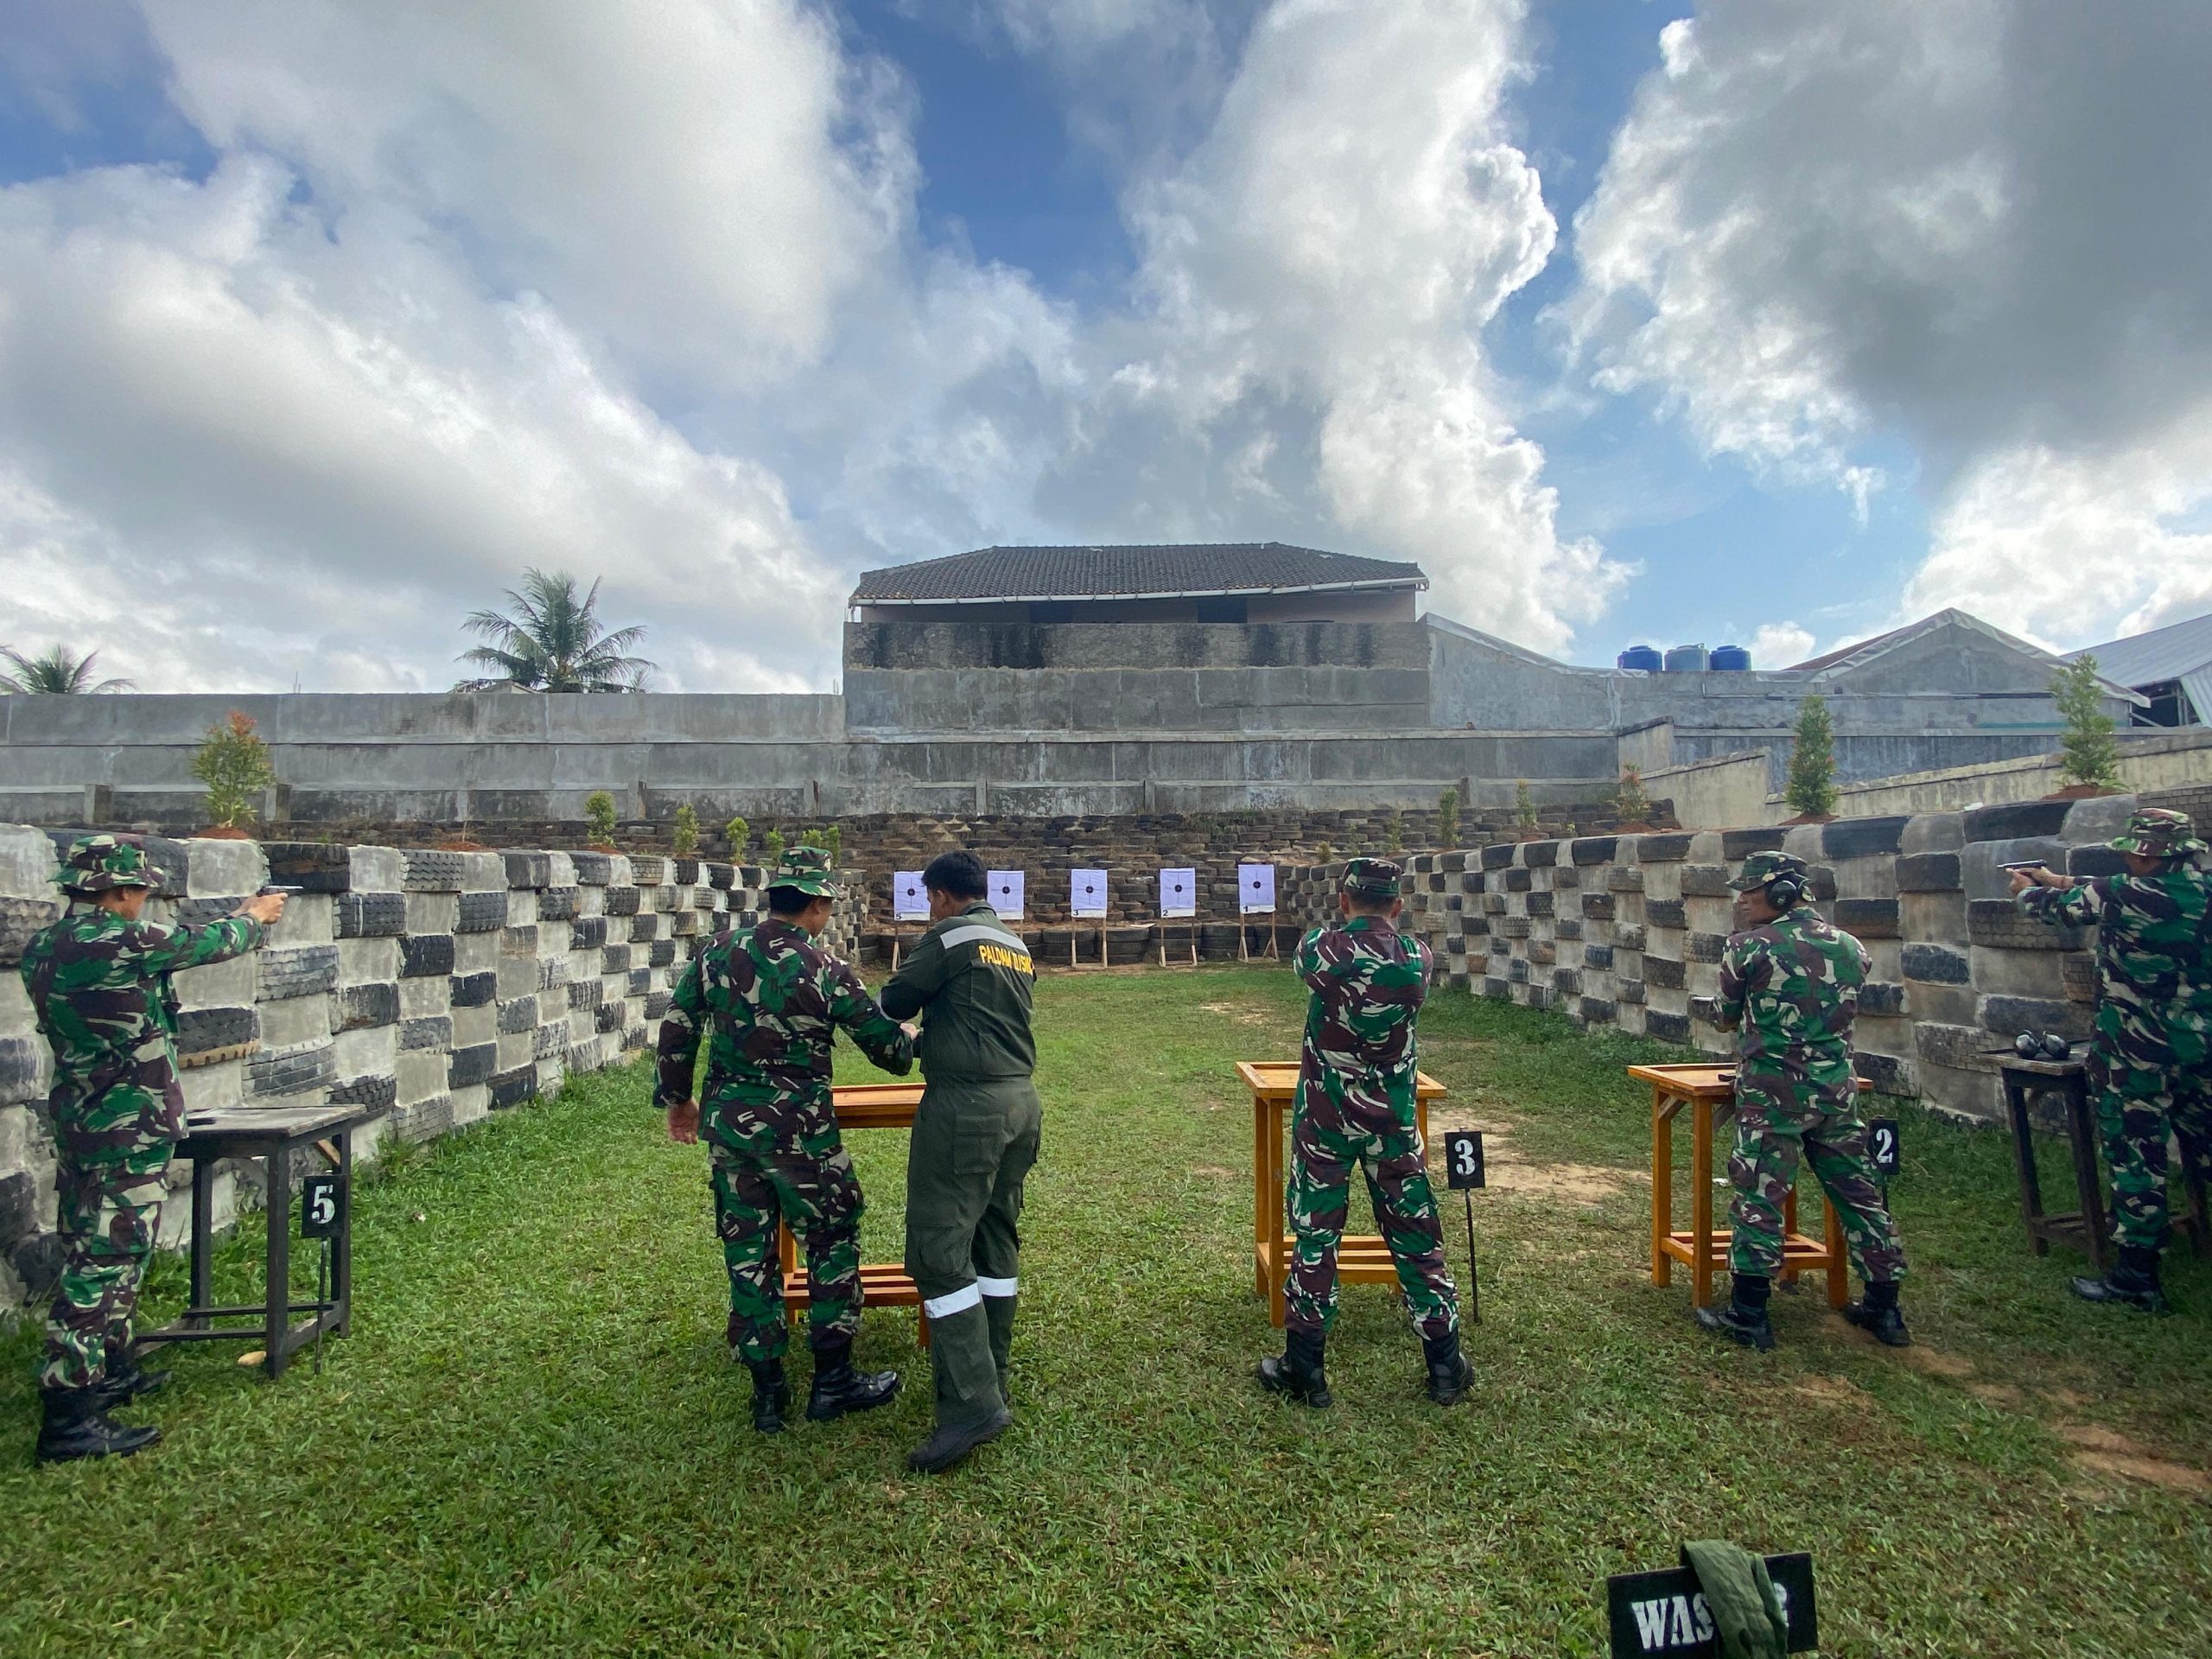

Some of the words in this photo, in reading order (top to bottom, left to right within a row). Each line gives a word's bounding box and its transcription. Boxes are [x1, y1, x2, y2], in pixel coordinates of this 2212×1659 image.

[978, 944, 1013, 969] PALDAM
[1454, 1139, 1476, 1176] 3
[1876, 1128, 1893, 1164] 2
[312, 1184, 335, 1224] 5
